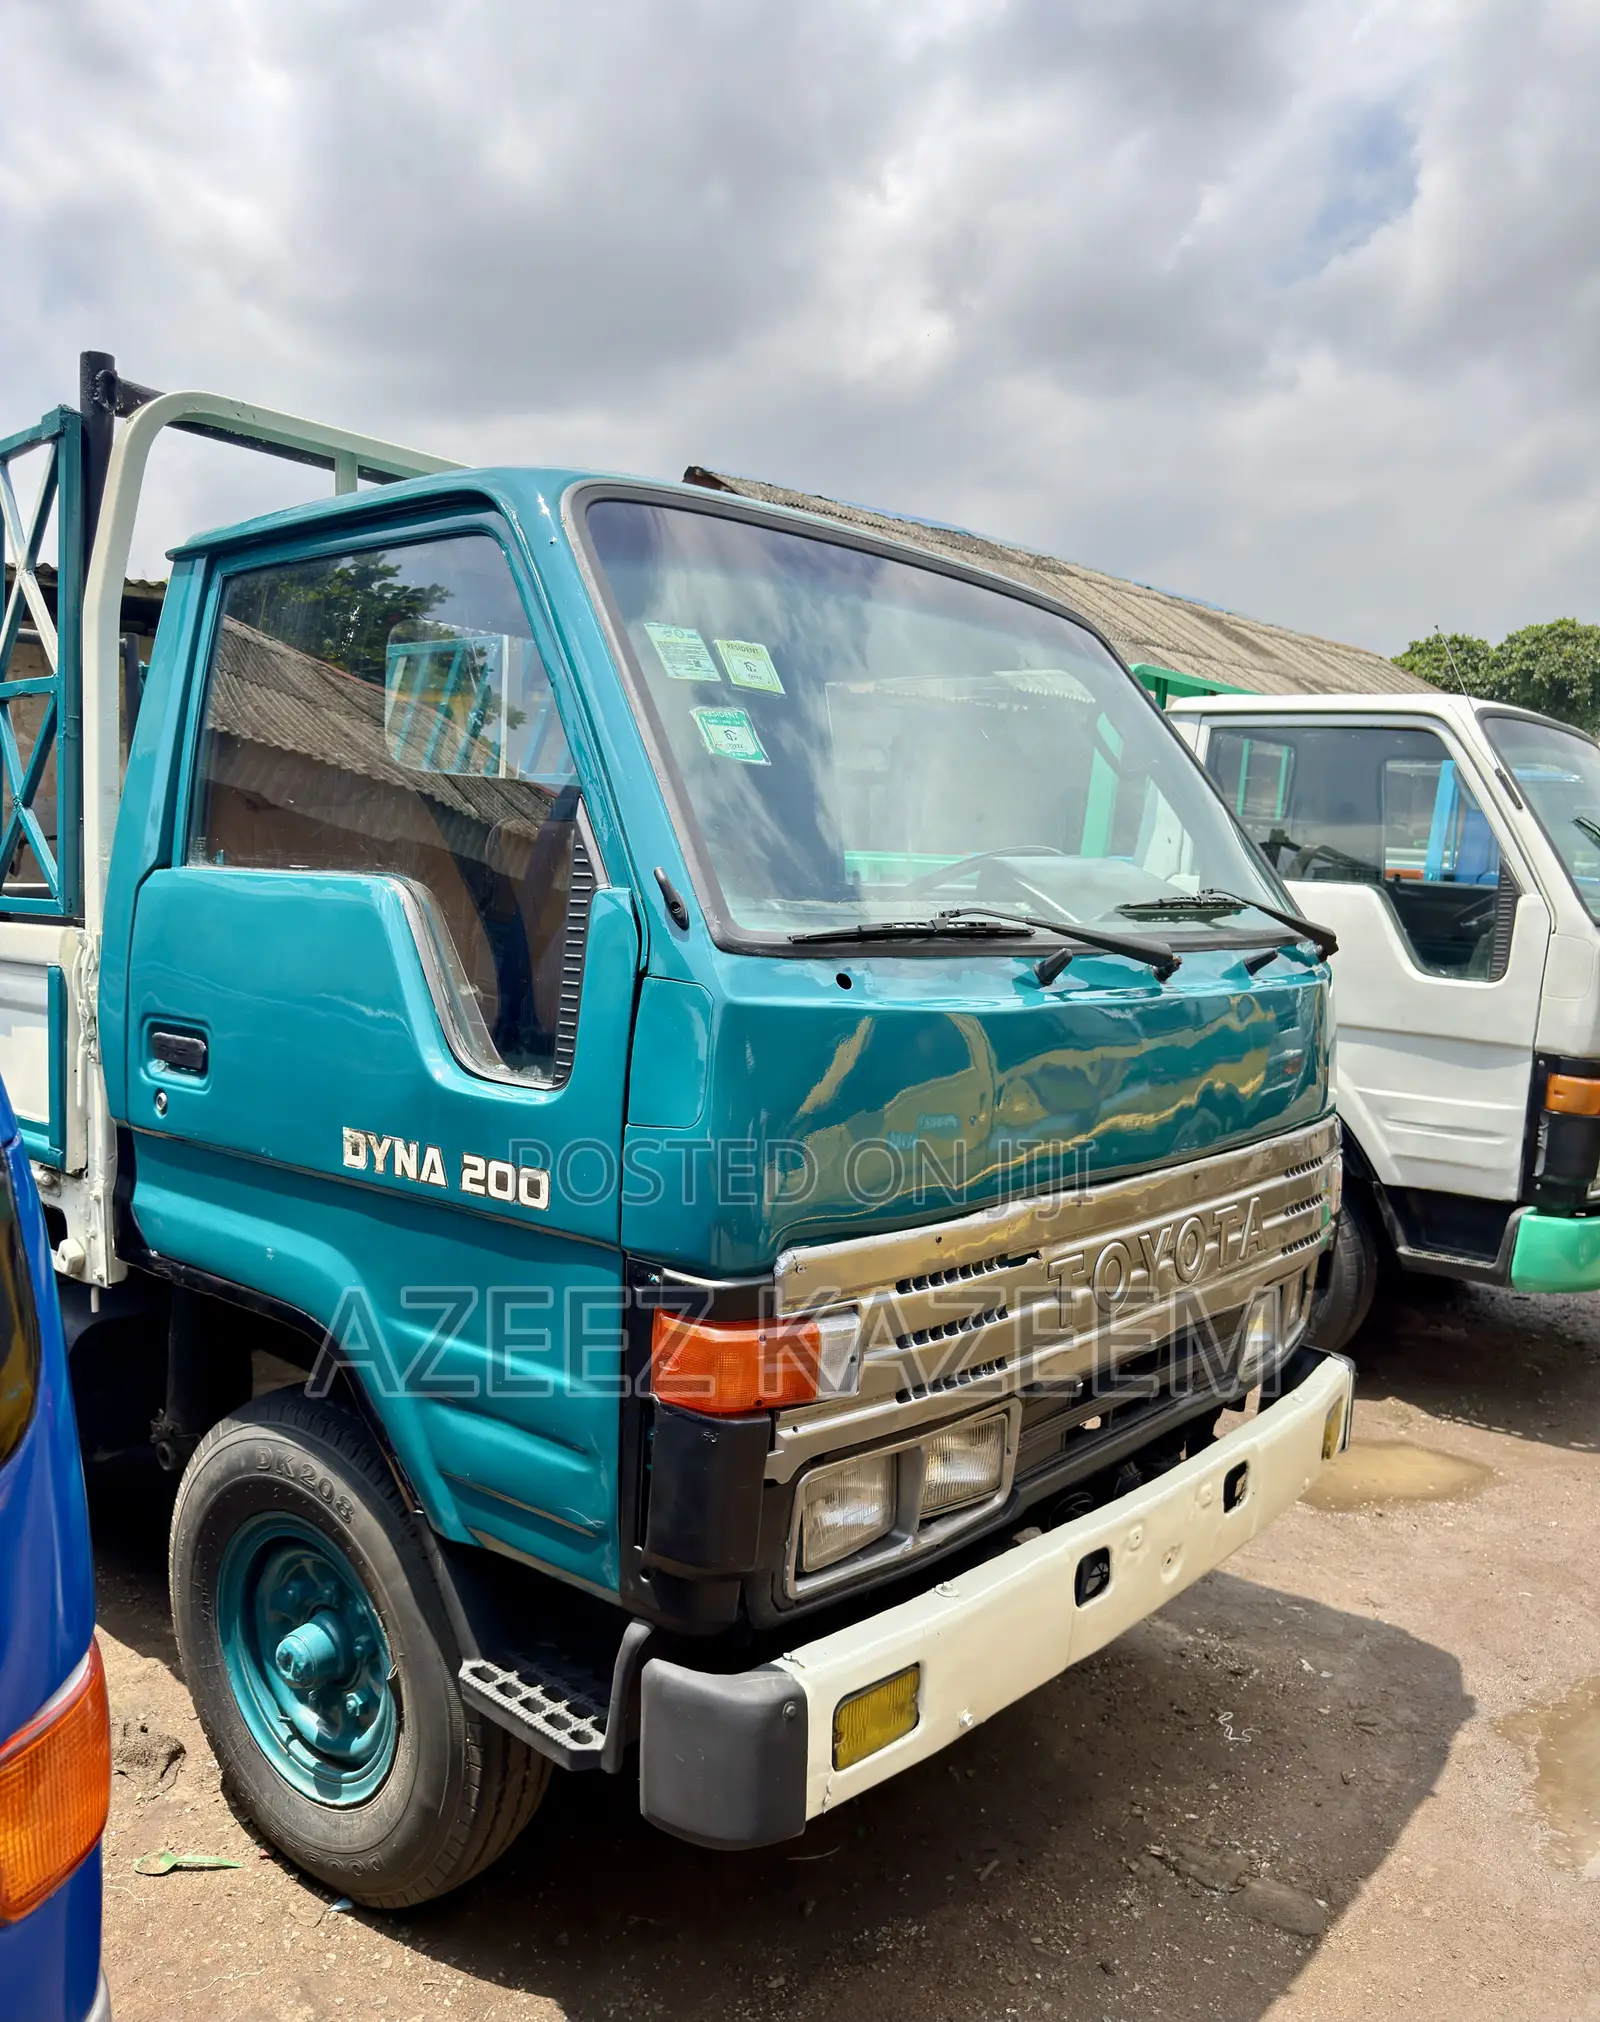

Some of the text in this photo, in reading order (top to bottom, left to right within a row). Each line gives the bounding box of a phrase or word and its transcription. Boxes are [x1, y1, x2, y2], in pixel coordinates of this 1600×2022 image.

[726, 643, 759, 655] RESIDENT
[342, 1127, 550, 1211] DYNA 200
[1048, 1196, 1267, 1332] TOYOTA
